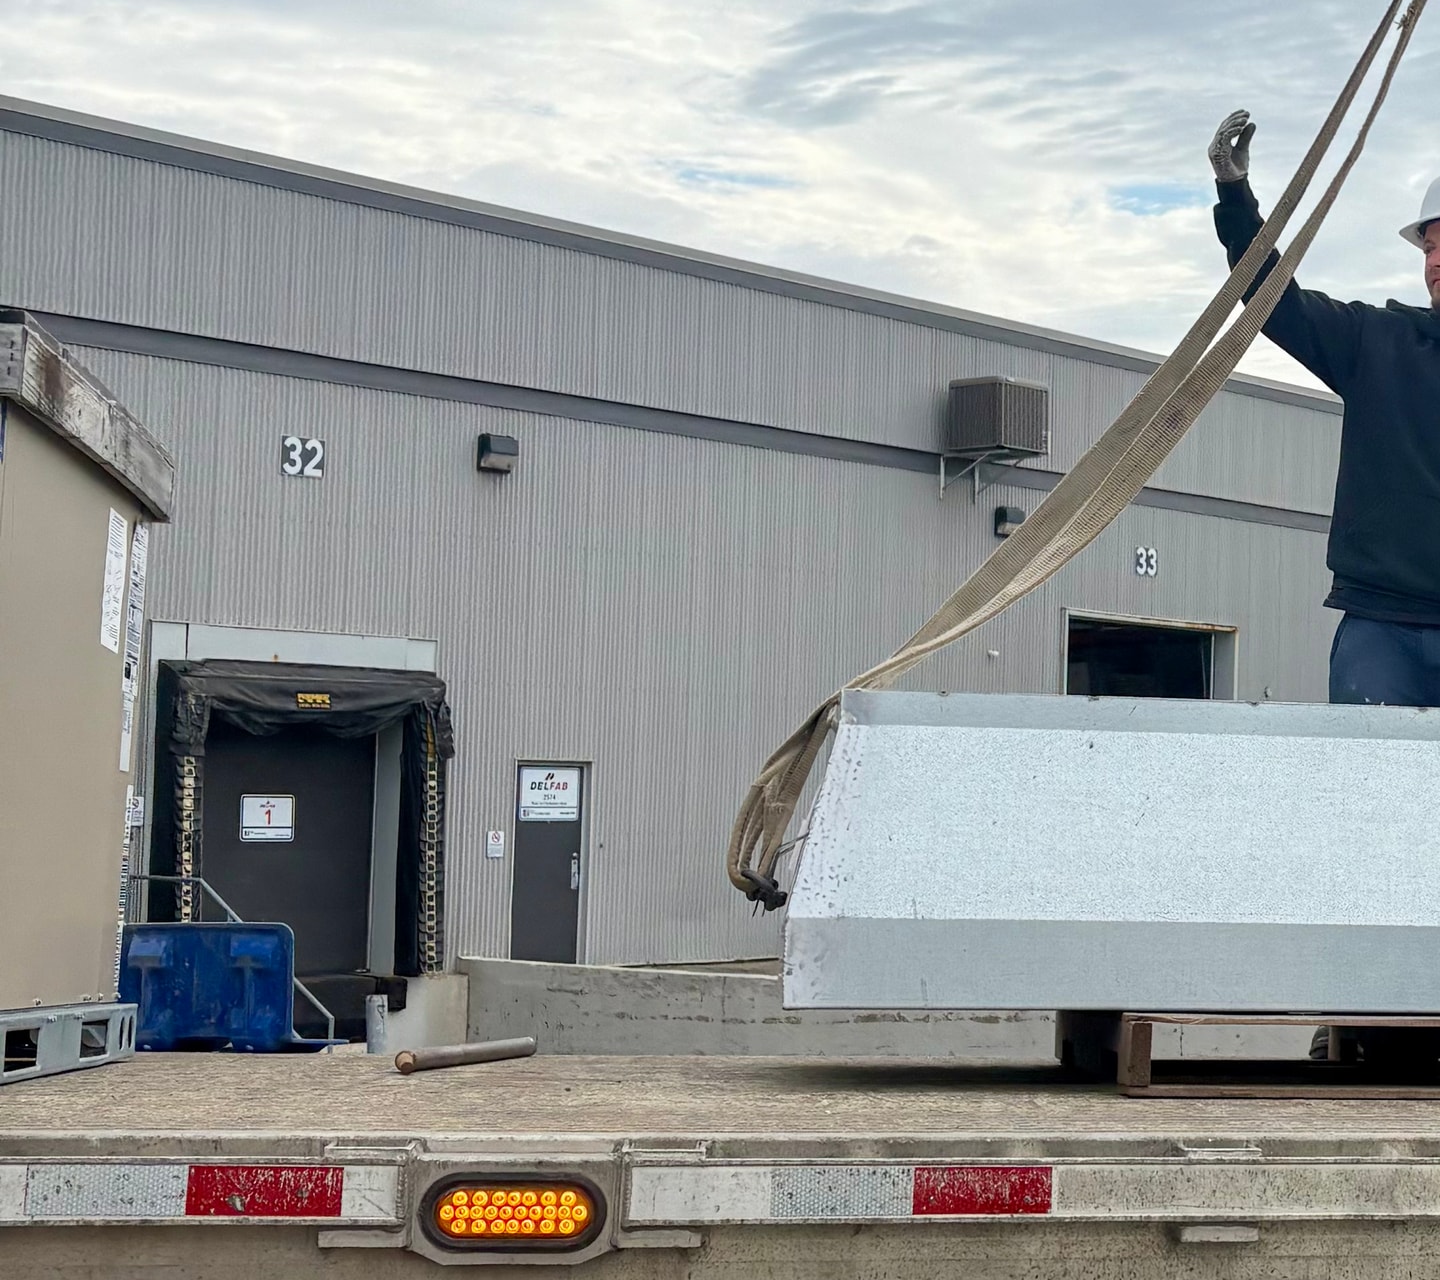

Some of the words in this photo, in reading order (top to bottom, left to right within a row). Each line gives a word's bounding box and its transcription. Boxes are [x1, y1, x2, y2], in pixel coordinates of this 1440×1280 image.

[283, 436, 323, 477] 32
[1136, 547, 1157, 576] 33
[530, 781, 568, 791] DELFAB
[265, 809, 271, 825] 1
